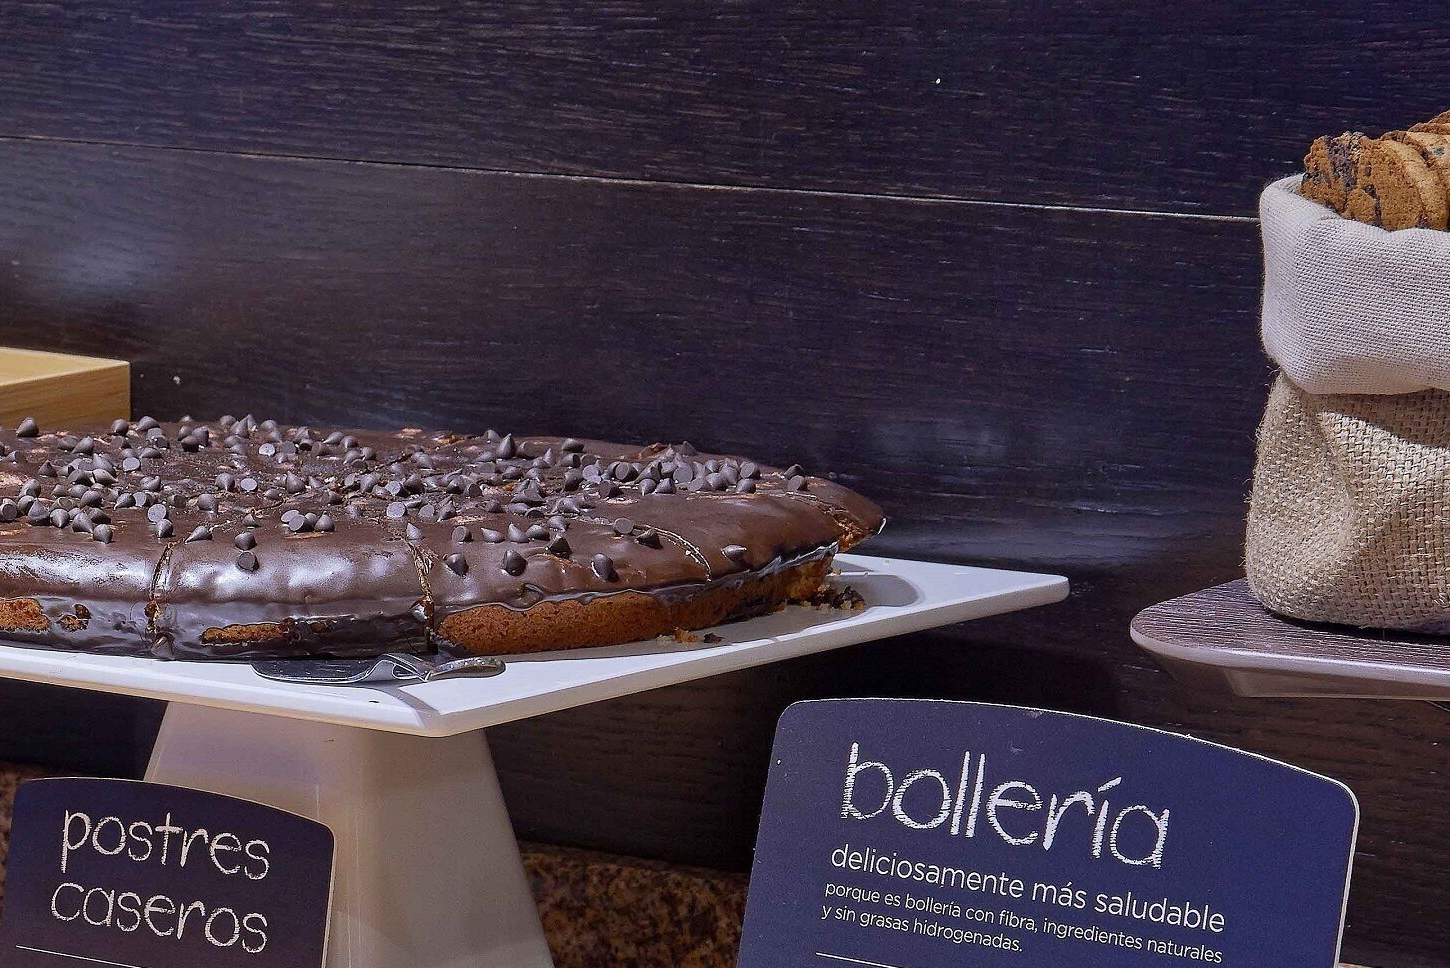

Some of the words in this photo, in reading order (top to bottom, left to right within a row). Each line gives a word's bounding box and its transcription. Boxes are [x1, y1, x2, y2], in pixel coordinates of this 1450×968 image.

[841, 743, 1170, 869] bollería
[61, 809, 270, 881] postres
[51, 882, 268, 954] caseros
[825, 884, 880, 902] porque
[885, 894, 900, 906] es
[905, 894, 960, 917] bollería
[966, 908, 994, 923] con
[1000, 910, 1037, 933] fibra,
[1044, 918, 1142, 949] ingredientes
[1148, 940, 1224, 965] naturales
[832, 846, 1023, 898] deliciosamente
[1032, 883, 1086, 908] más
[1095, 892, 1224, 932] saludable
[822, 906, 832, 919] y
[835, 908, 855, 922] sin
[860, 913, 909, 931] grasas
[914, 918, 1022, 951] hidrogenadas.
